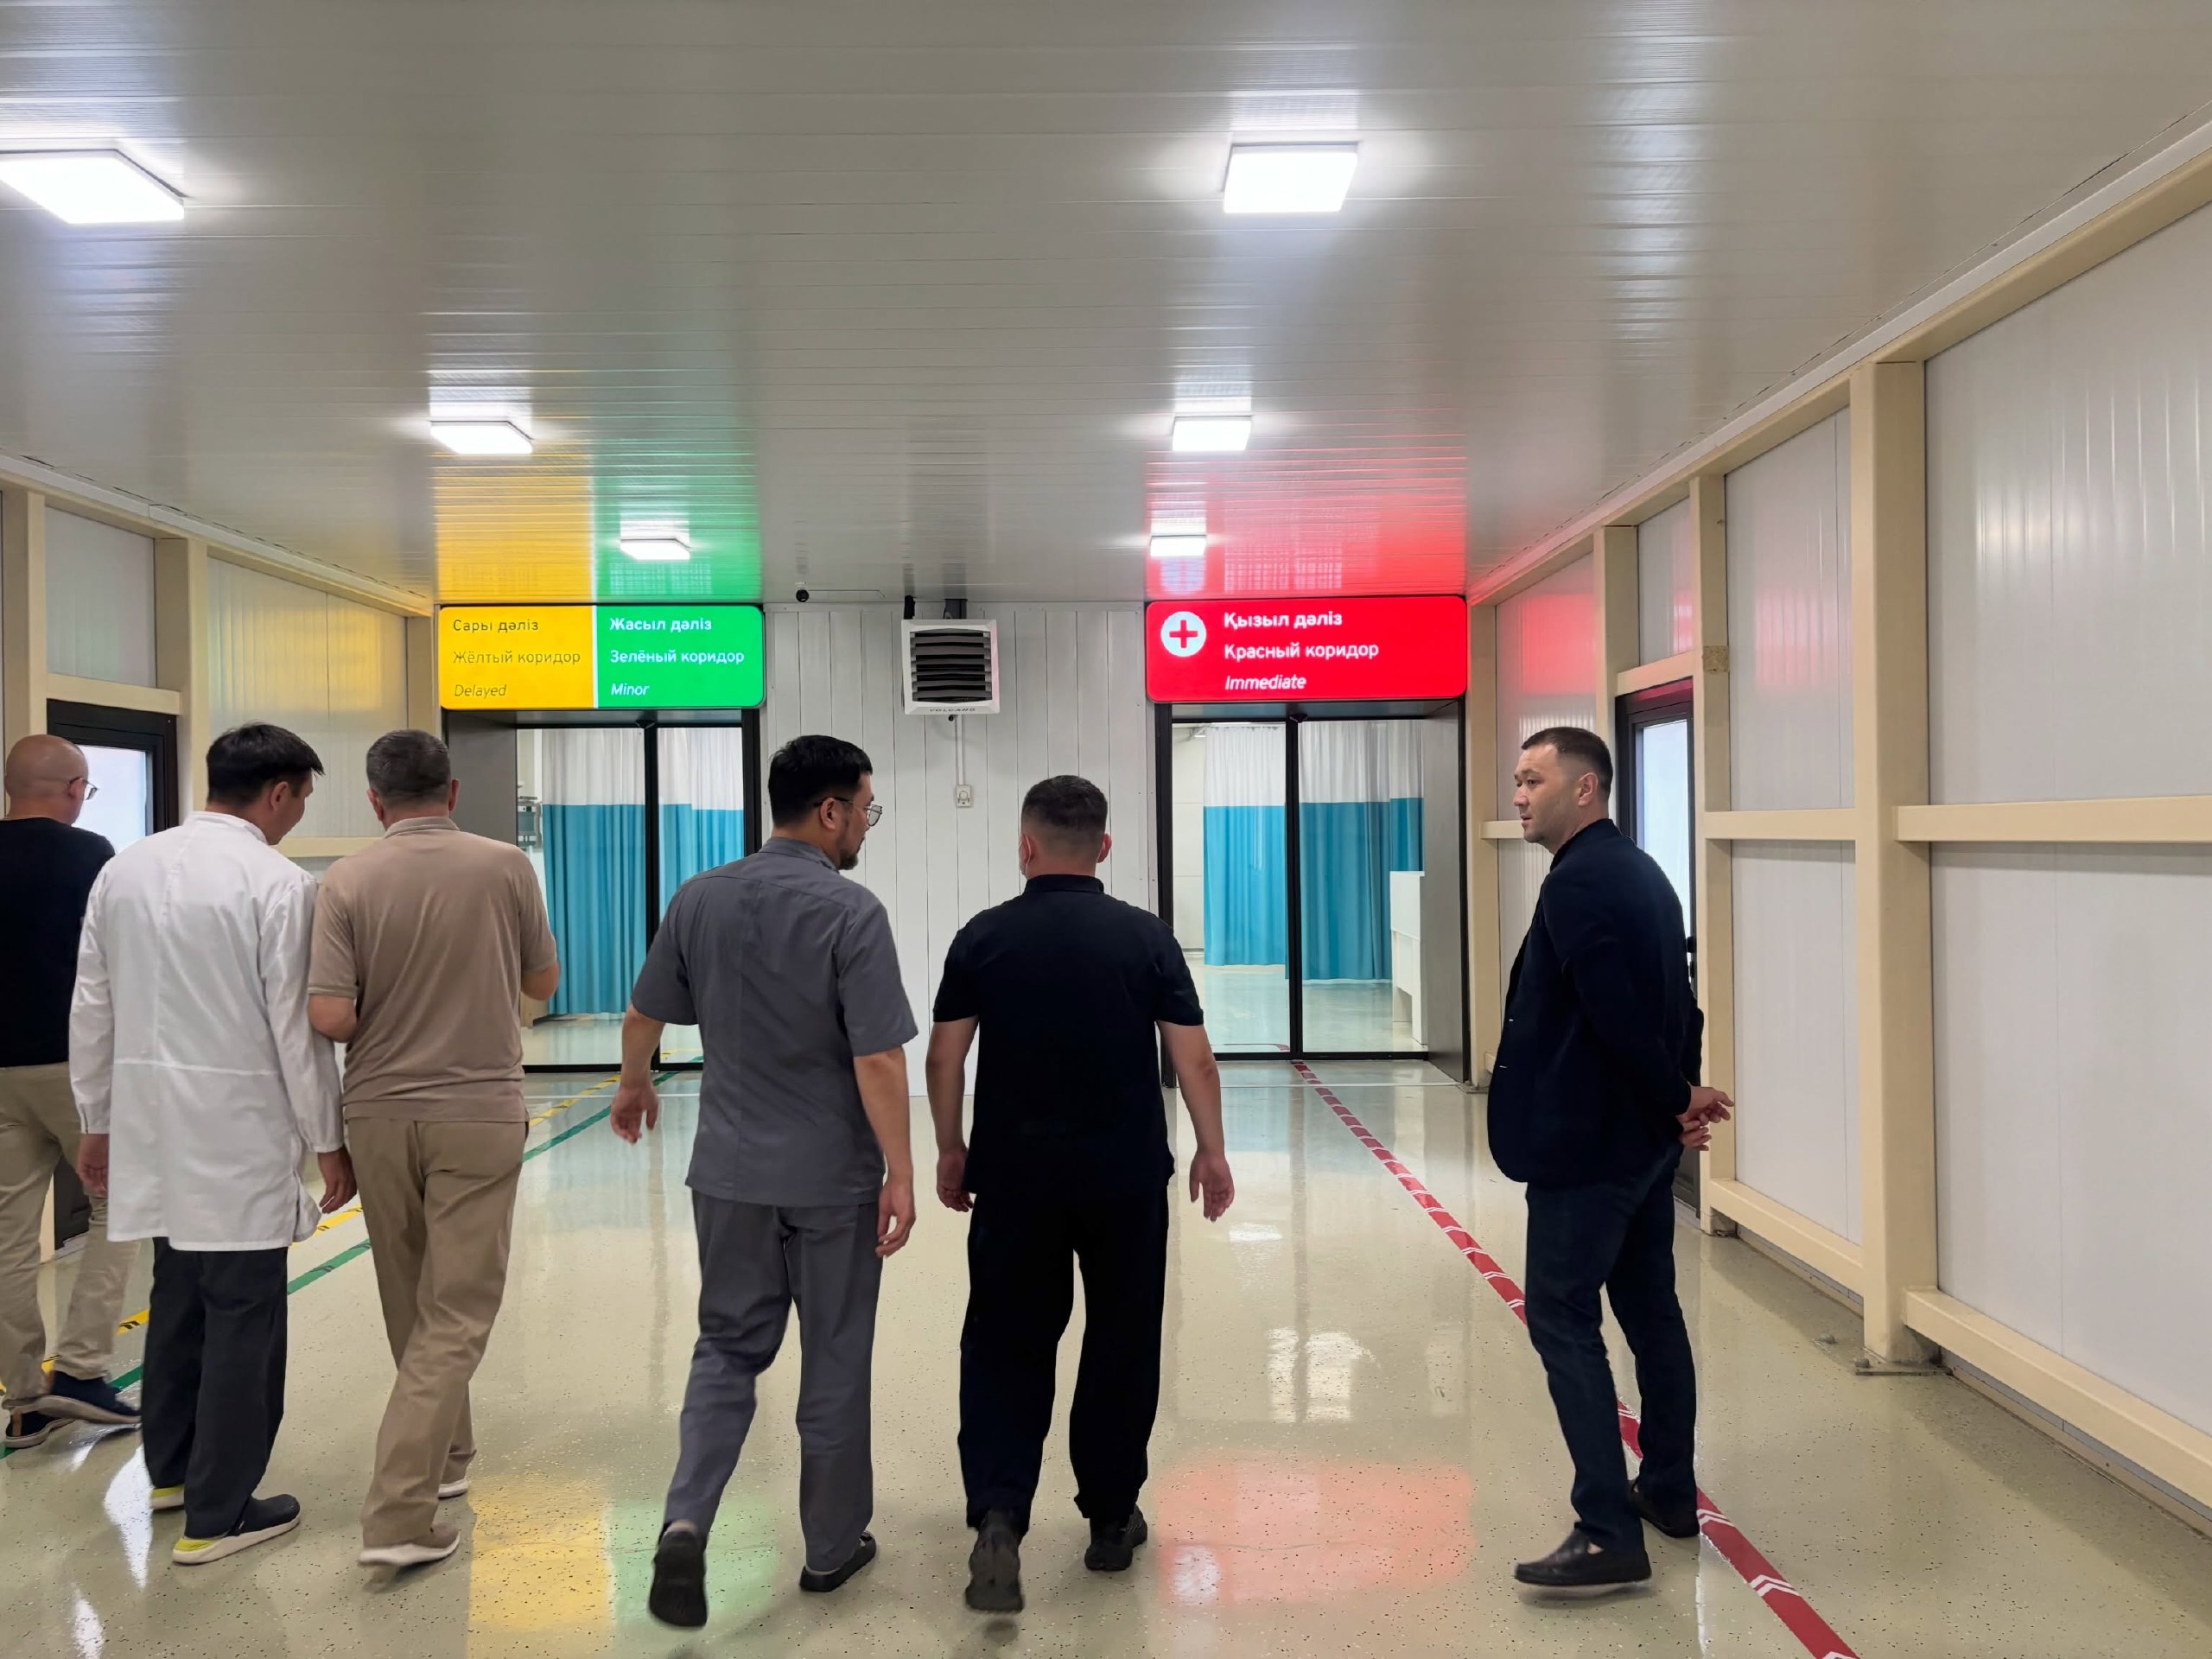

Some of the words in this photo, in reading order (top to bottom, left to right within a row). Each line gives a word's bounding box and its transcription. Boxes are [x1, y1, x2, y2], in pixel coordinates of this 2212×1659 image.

[453, 620, 493, 633] Сары
[498, 619, 539, 632] дәліз
[610, 617, 666, 631] Жасыл
[671, 617, 712, 632] дәліз
[1224, 612, 1289, 630] Қызыл
[1294, 611, 1343, 629] дәліз
[453, 650, 513, 664] Жёлтый
[518, 652, 581, 665] коридор
[610, 649, 677, 663] Зелёный
[681, 652, 745, 665] коридор
[1224, 642, 1300, 662] Красный
[1306, 644, 1379, 660] коридор
[611, 683, 650, 696] Minor
[1225, 674, 1307, 690] Immediate
[454, 684, 507, 698] Delayed
